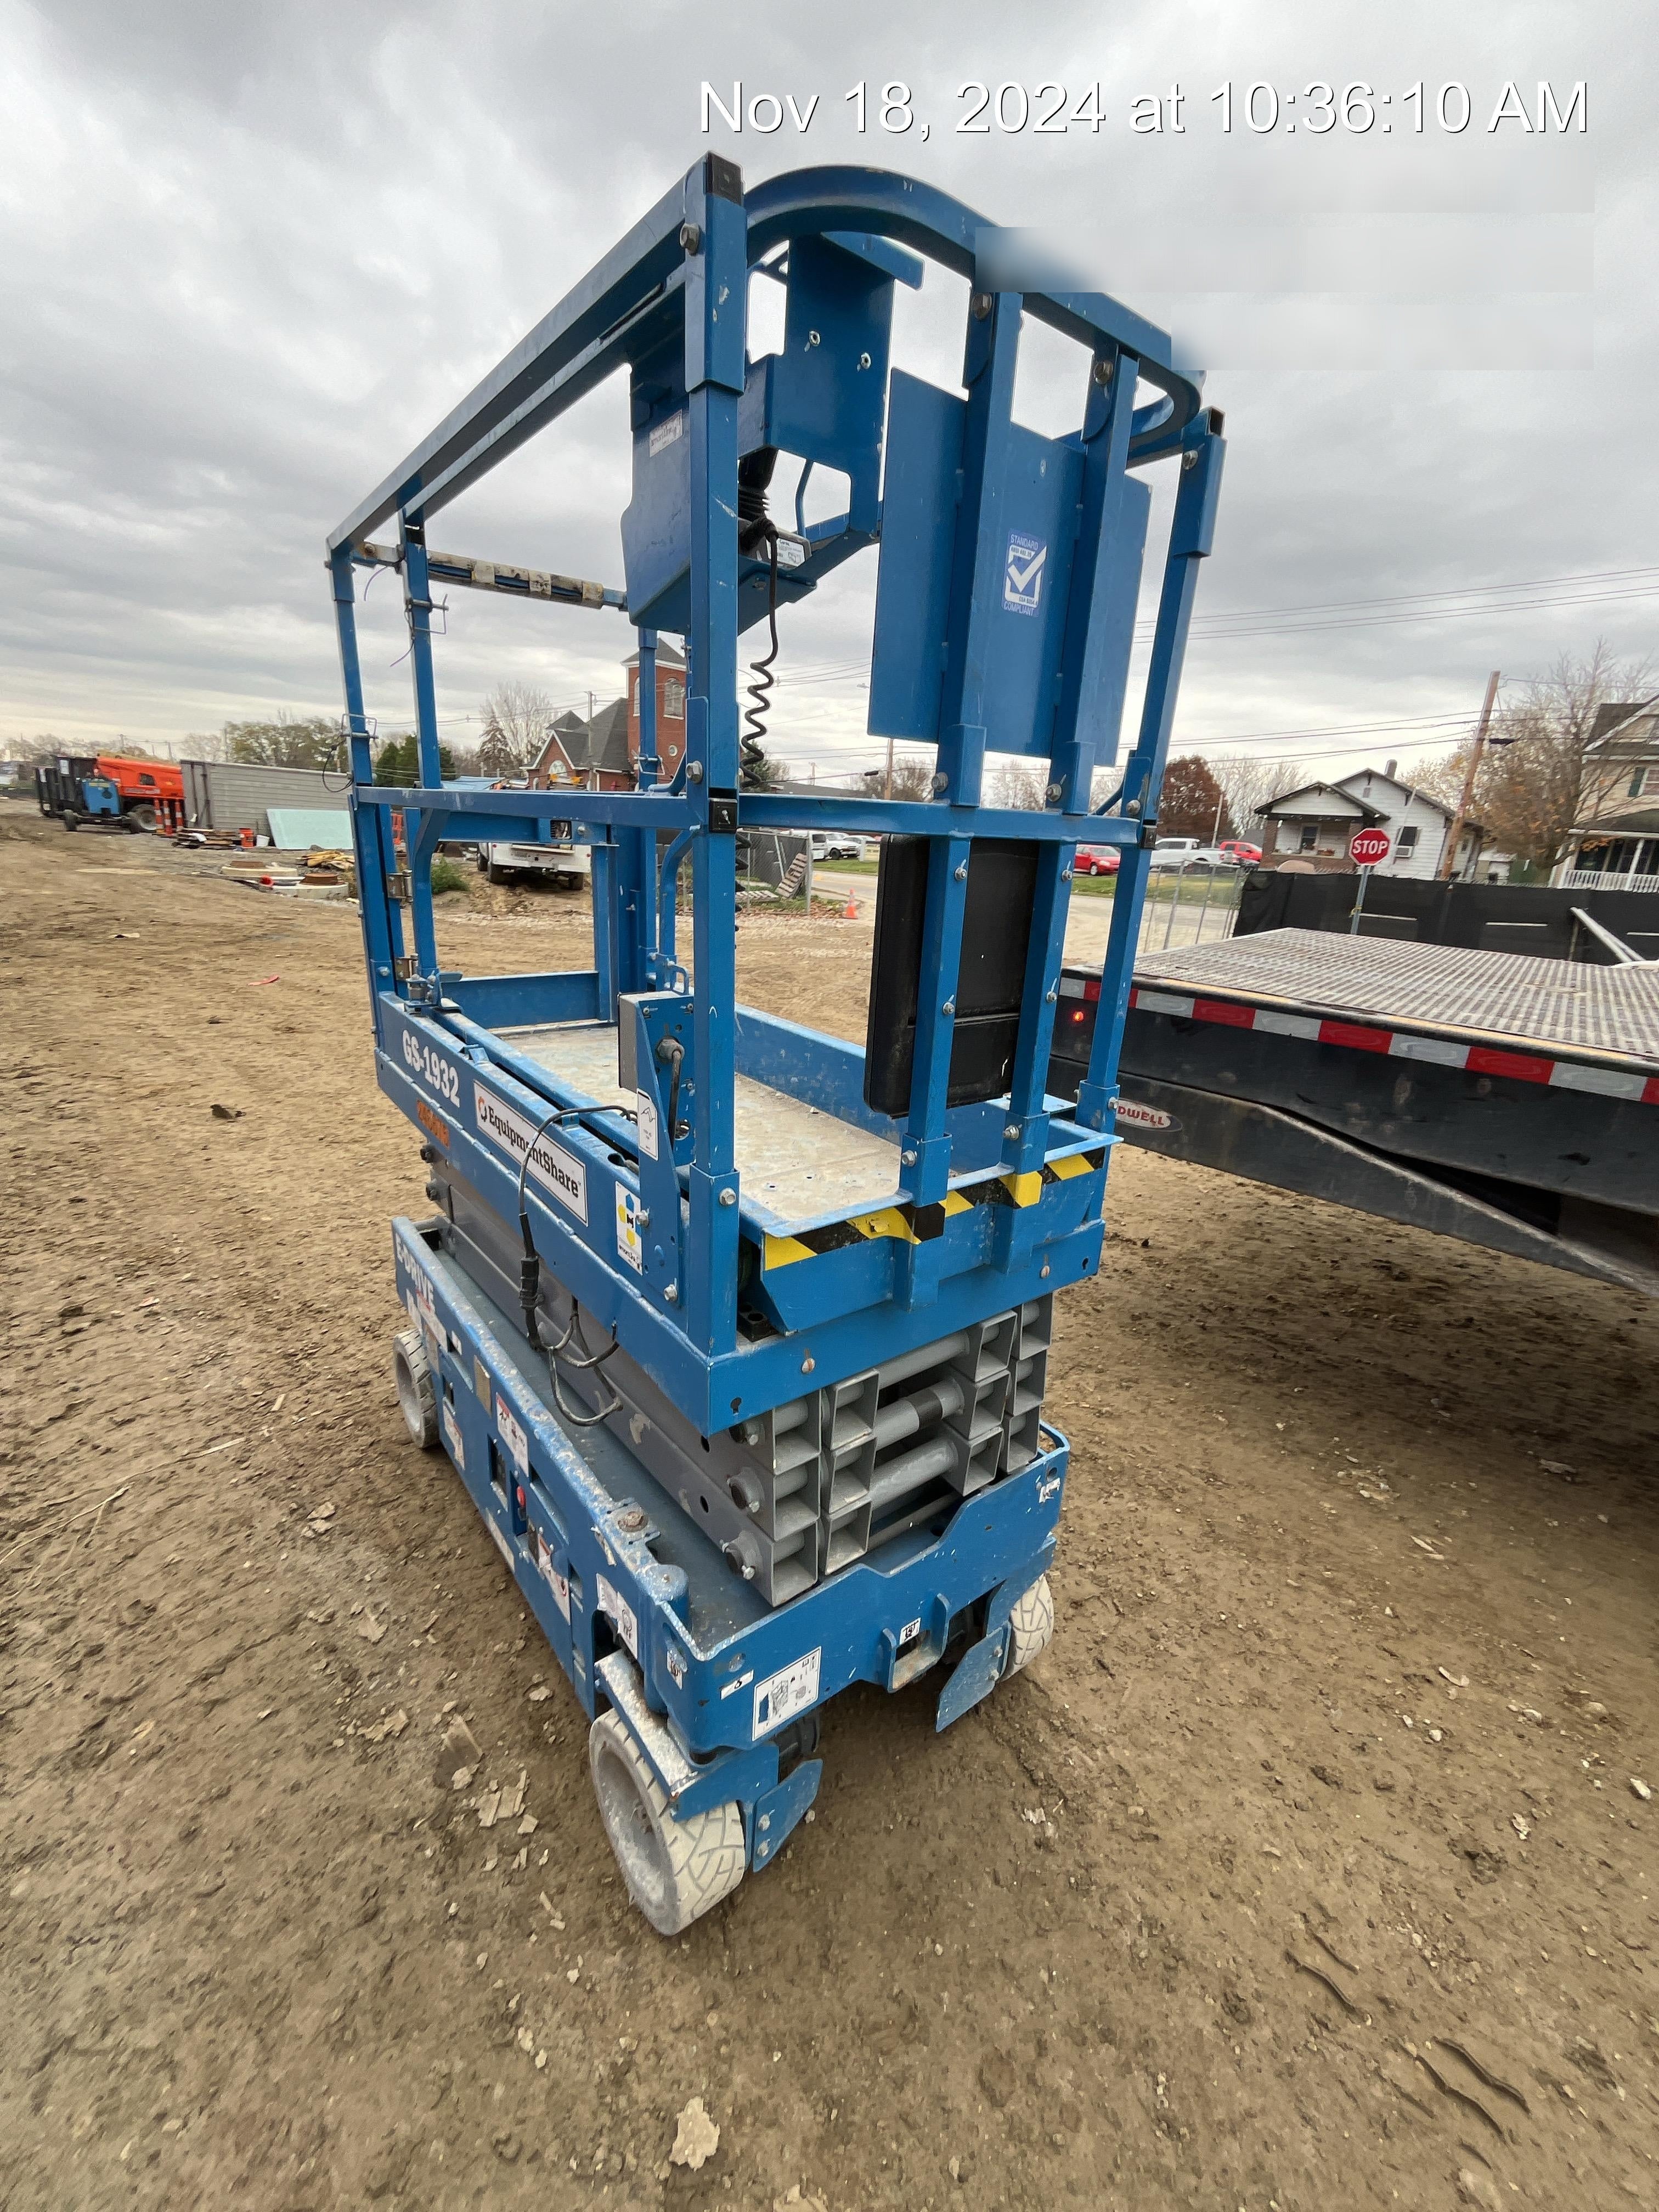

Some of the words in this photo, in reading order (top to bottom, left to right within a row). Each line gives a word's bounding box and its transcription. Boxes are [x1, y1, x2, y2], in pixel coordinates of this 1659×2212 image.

[1011, 534, 1039, 550] STANDARD
[1004, 601, 1034, 617] COMPLIANT
[1352, 840, 1389, 855] STOP
[402, 1029, 460, 1108] GS-1932
[1117, 1105, 1164, 1126] DWELL
